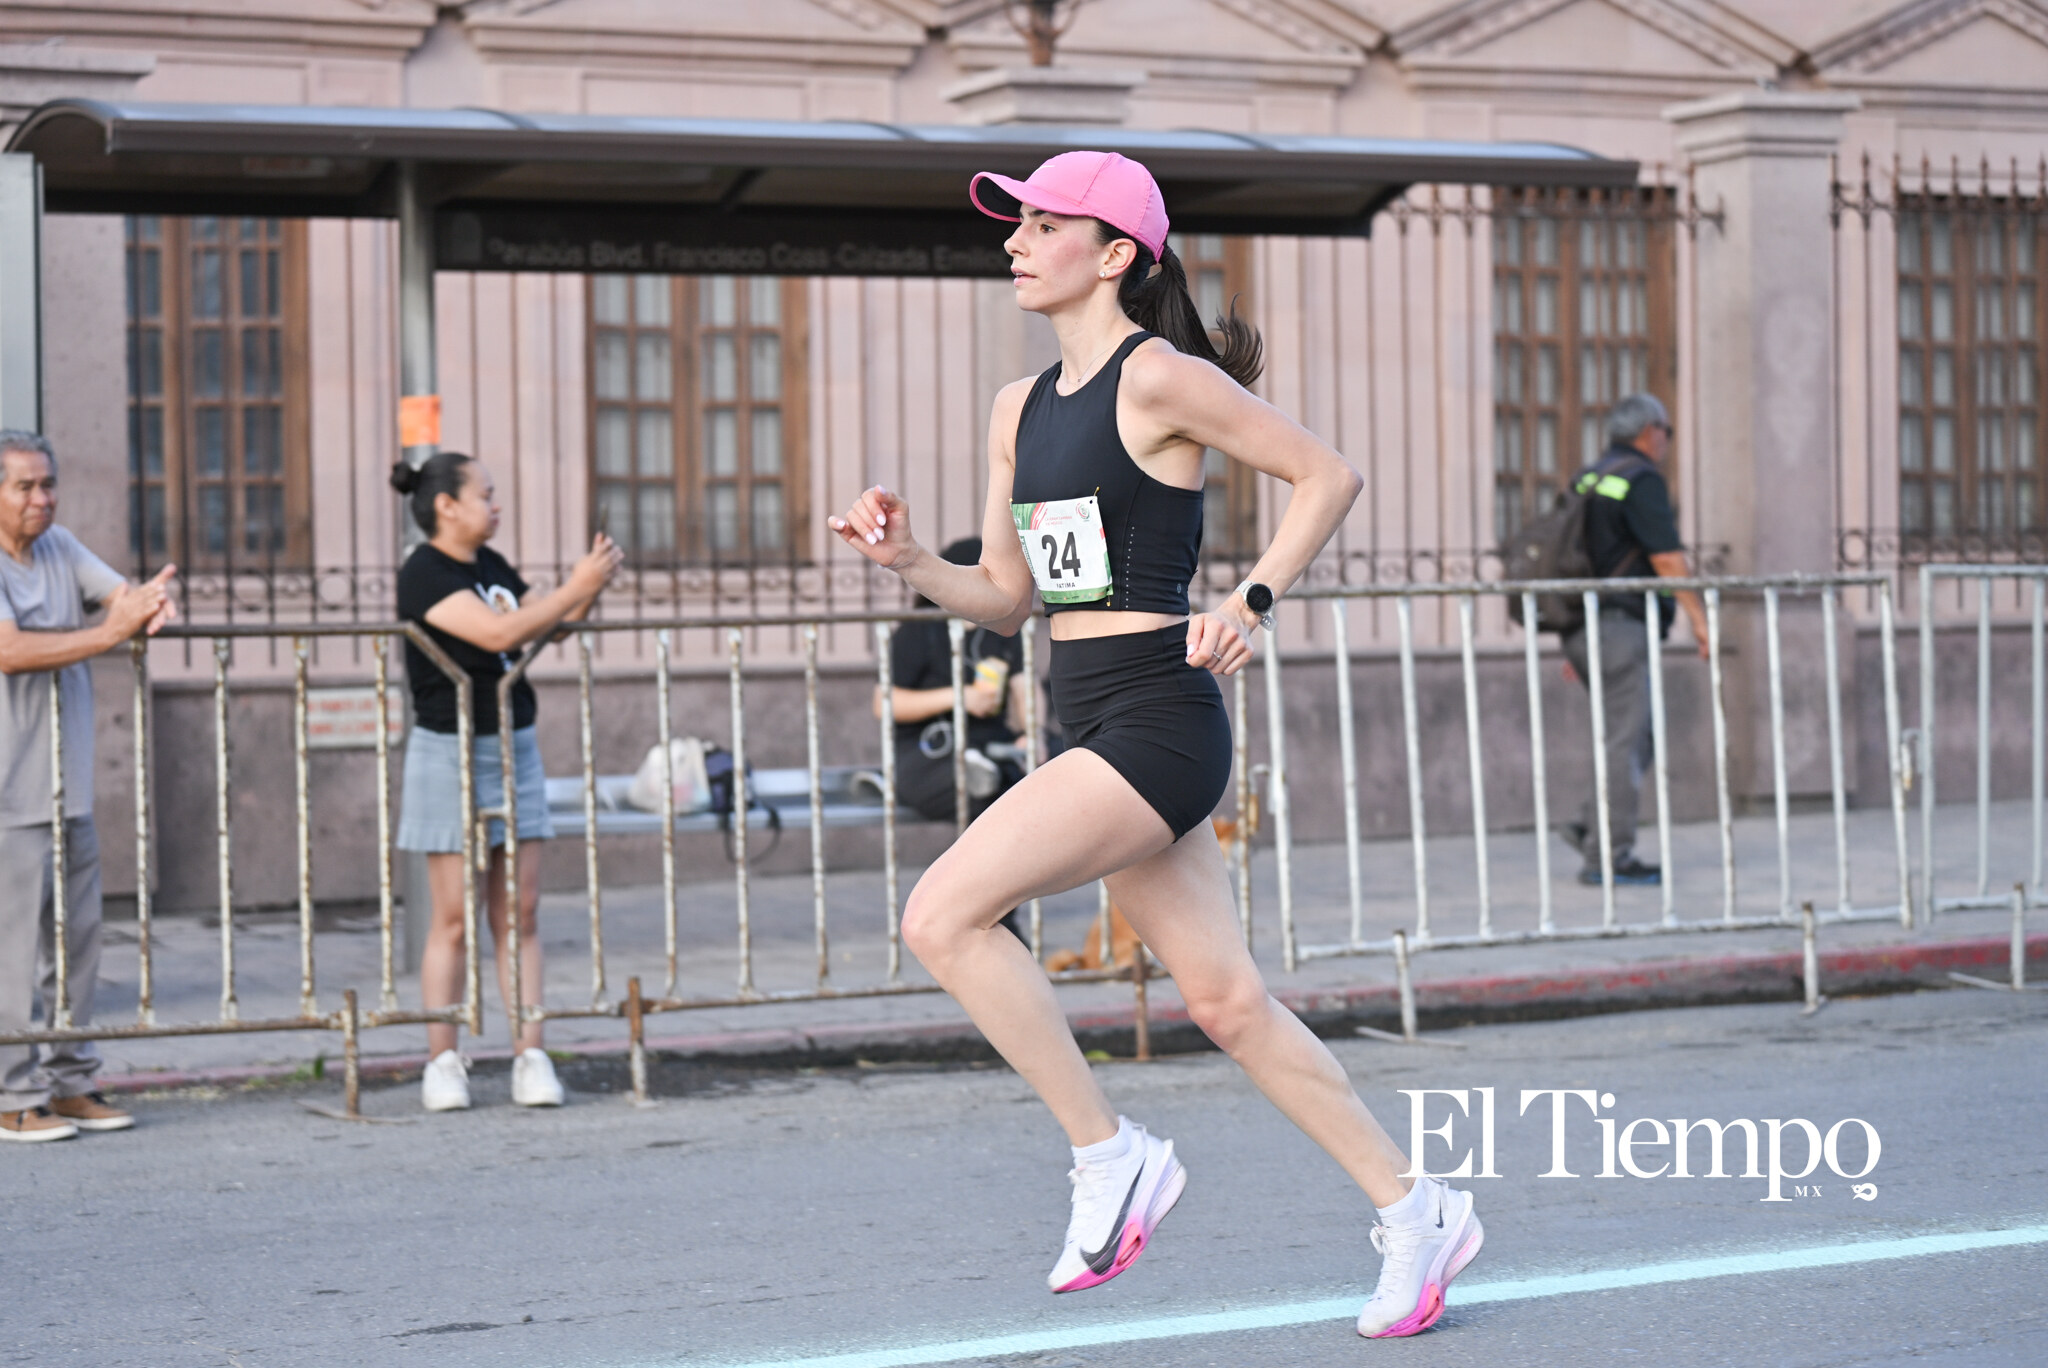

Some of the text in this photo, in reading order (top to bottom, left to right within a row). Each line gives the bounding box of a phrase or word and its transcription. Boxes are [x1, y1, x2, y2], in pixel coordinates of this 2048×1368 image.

[589, 240, 649, 267] Blvd.
[653, 241, 766, 269] Francisco
[770, 242, 828, 268] Coss
[1042, 532, 1081, 579] 24
